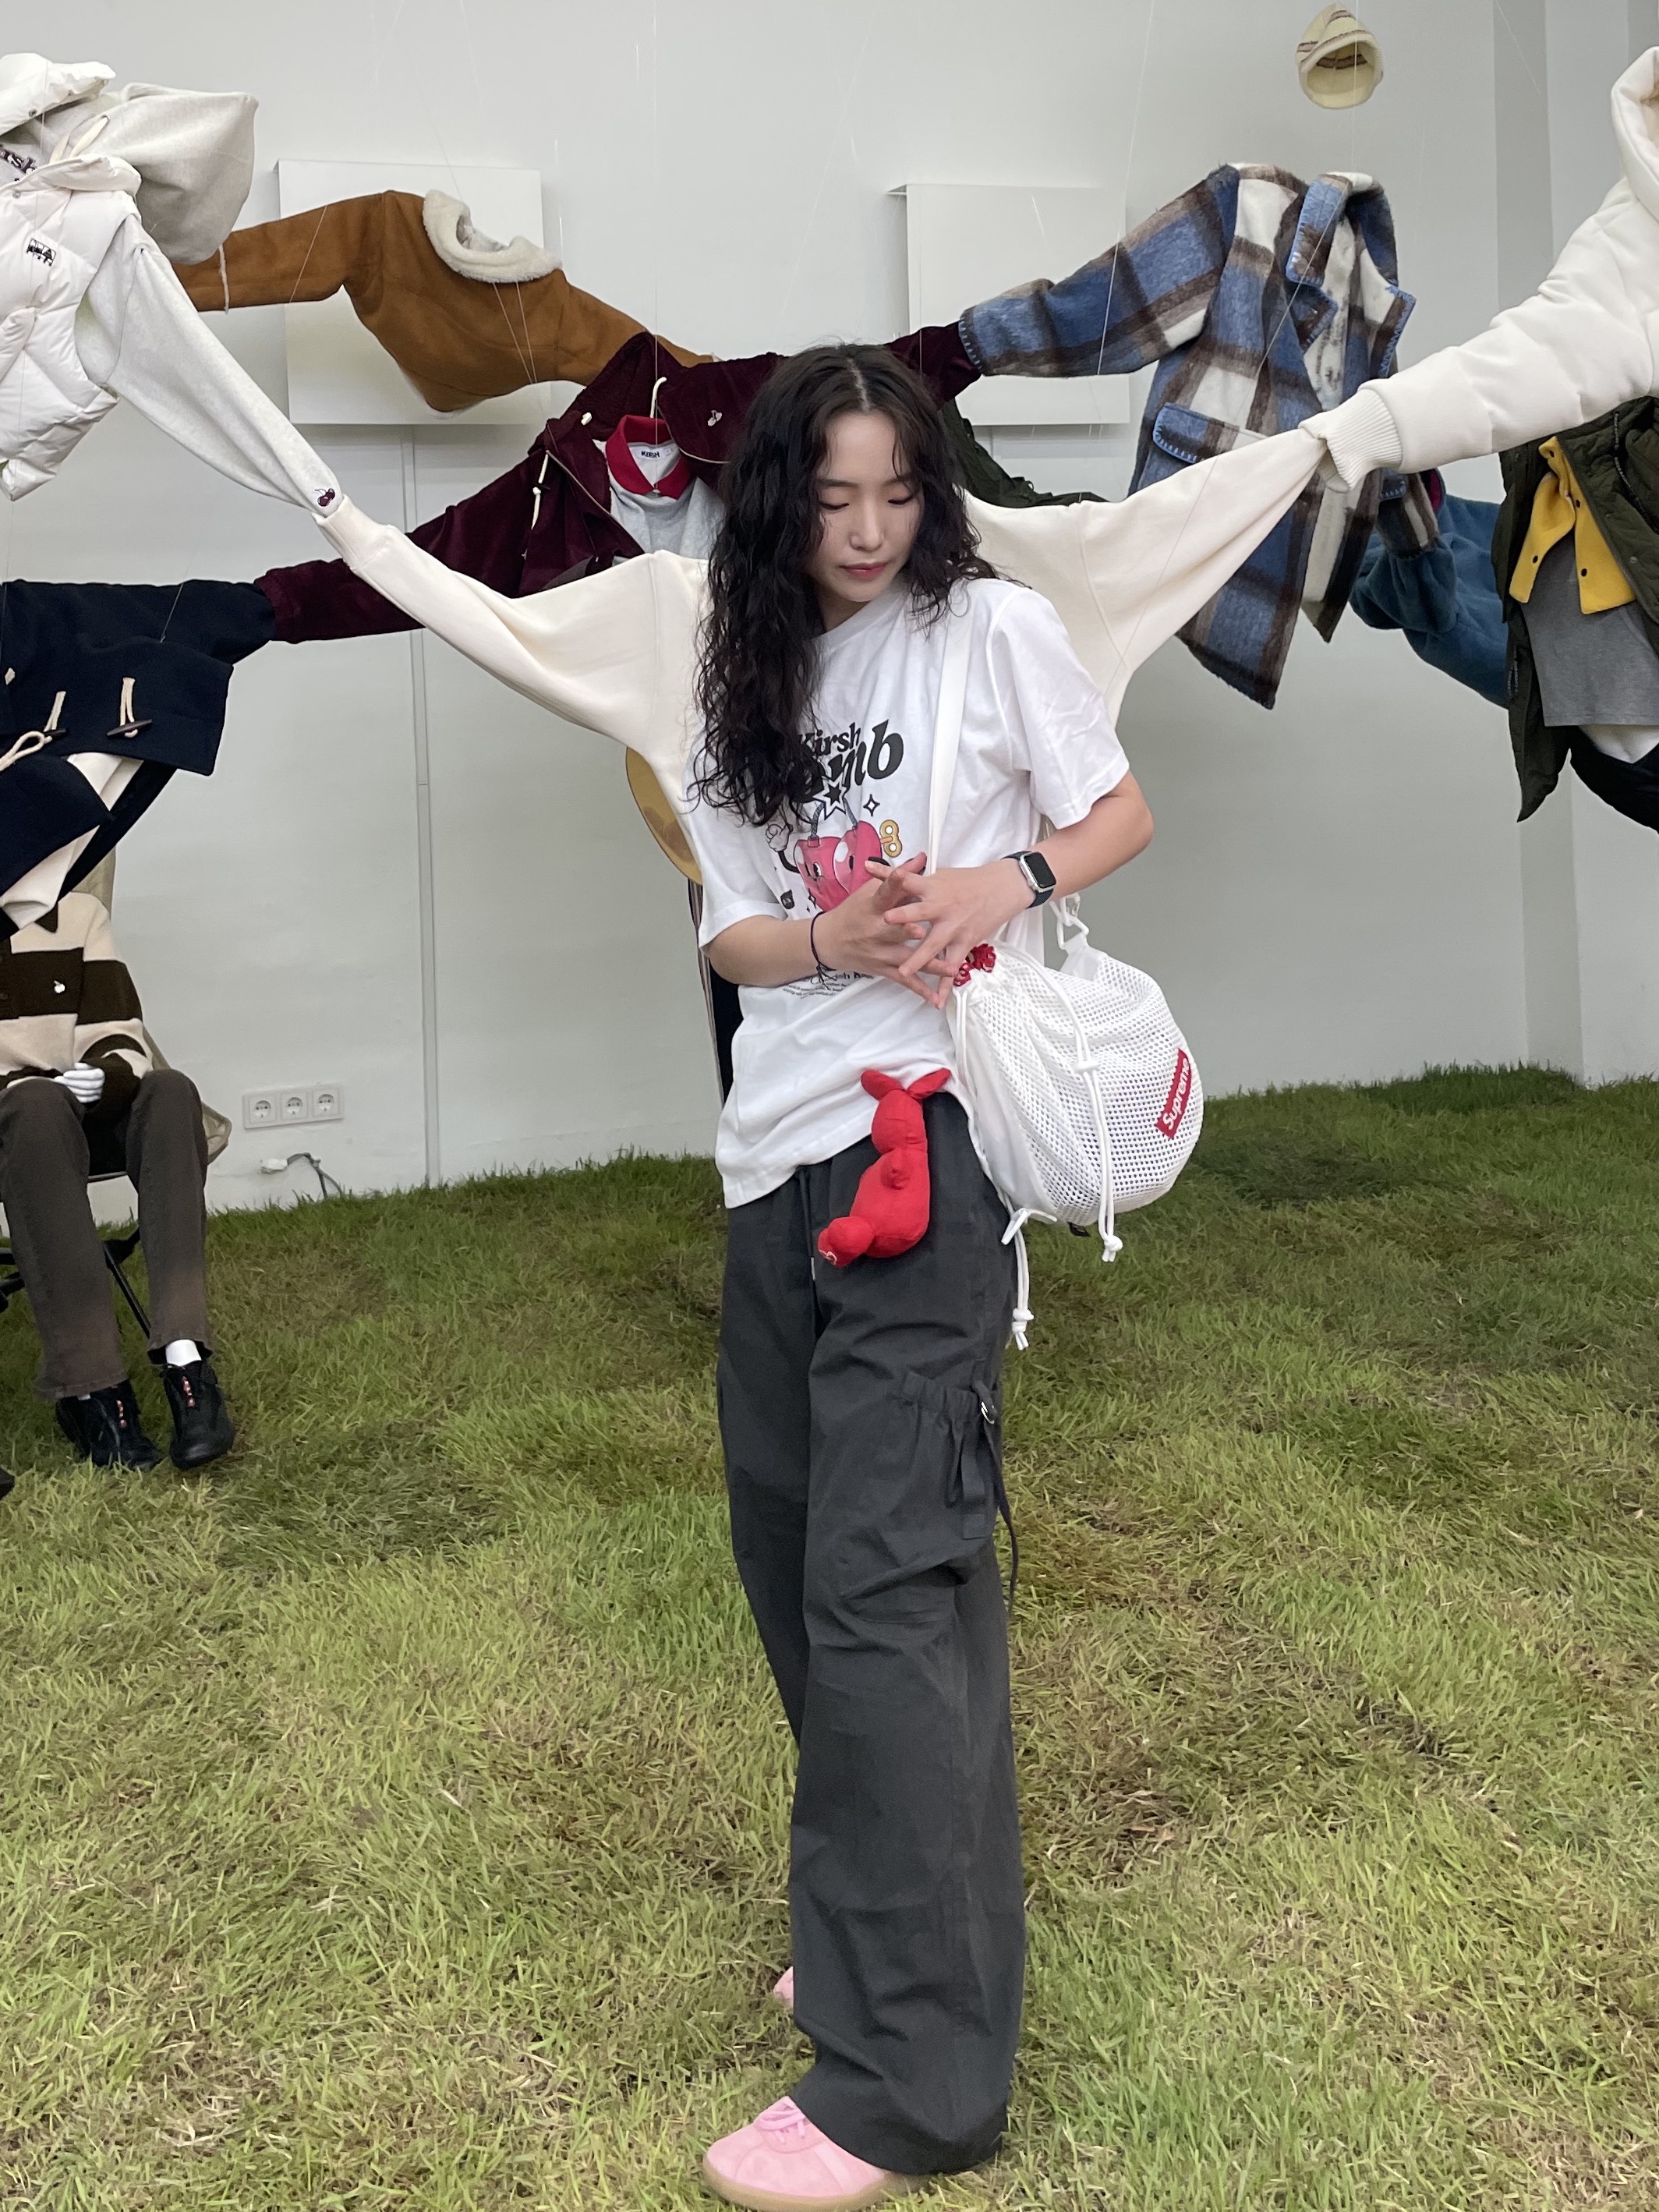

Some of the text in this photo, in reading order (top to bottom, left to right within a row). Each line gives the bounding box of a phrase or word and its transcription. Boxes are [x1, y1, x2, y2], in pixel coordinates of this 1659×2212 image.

[0, 143, 37, 175] rsh
[798, 721, 861, 756] Kirsh
[1162, 1057, 1190, 1131] Supreme
